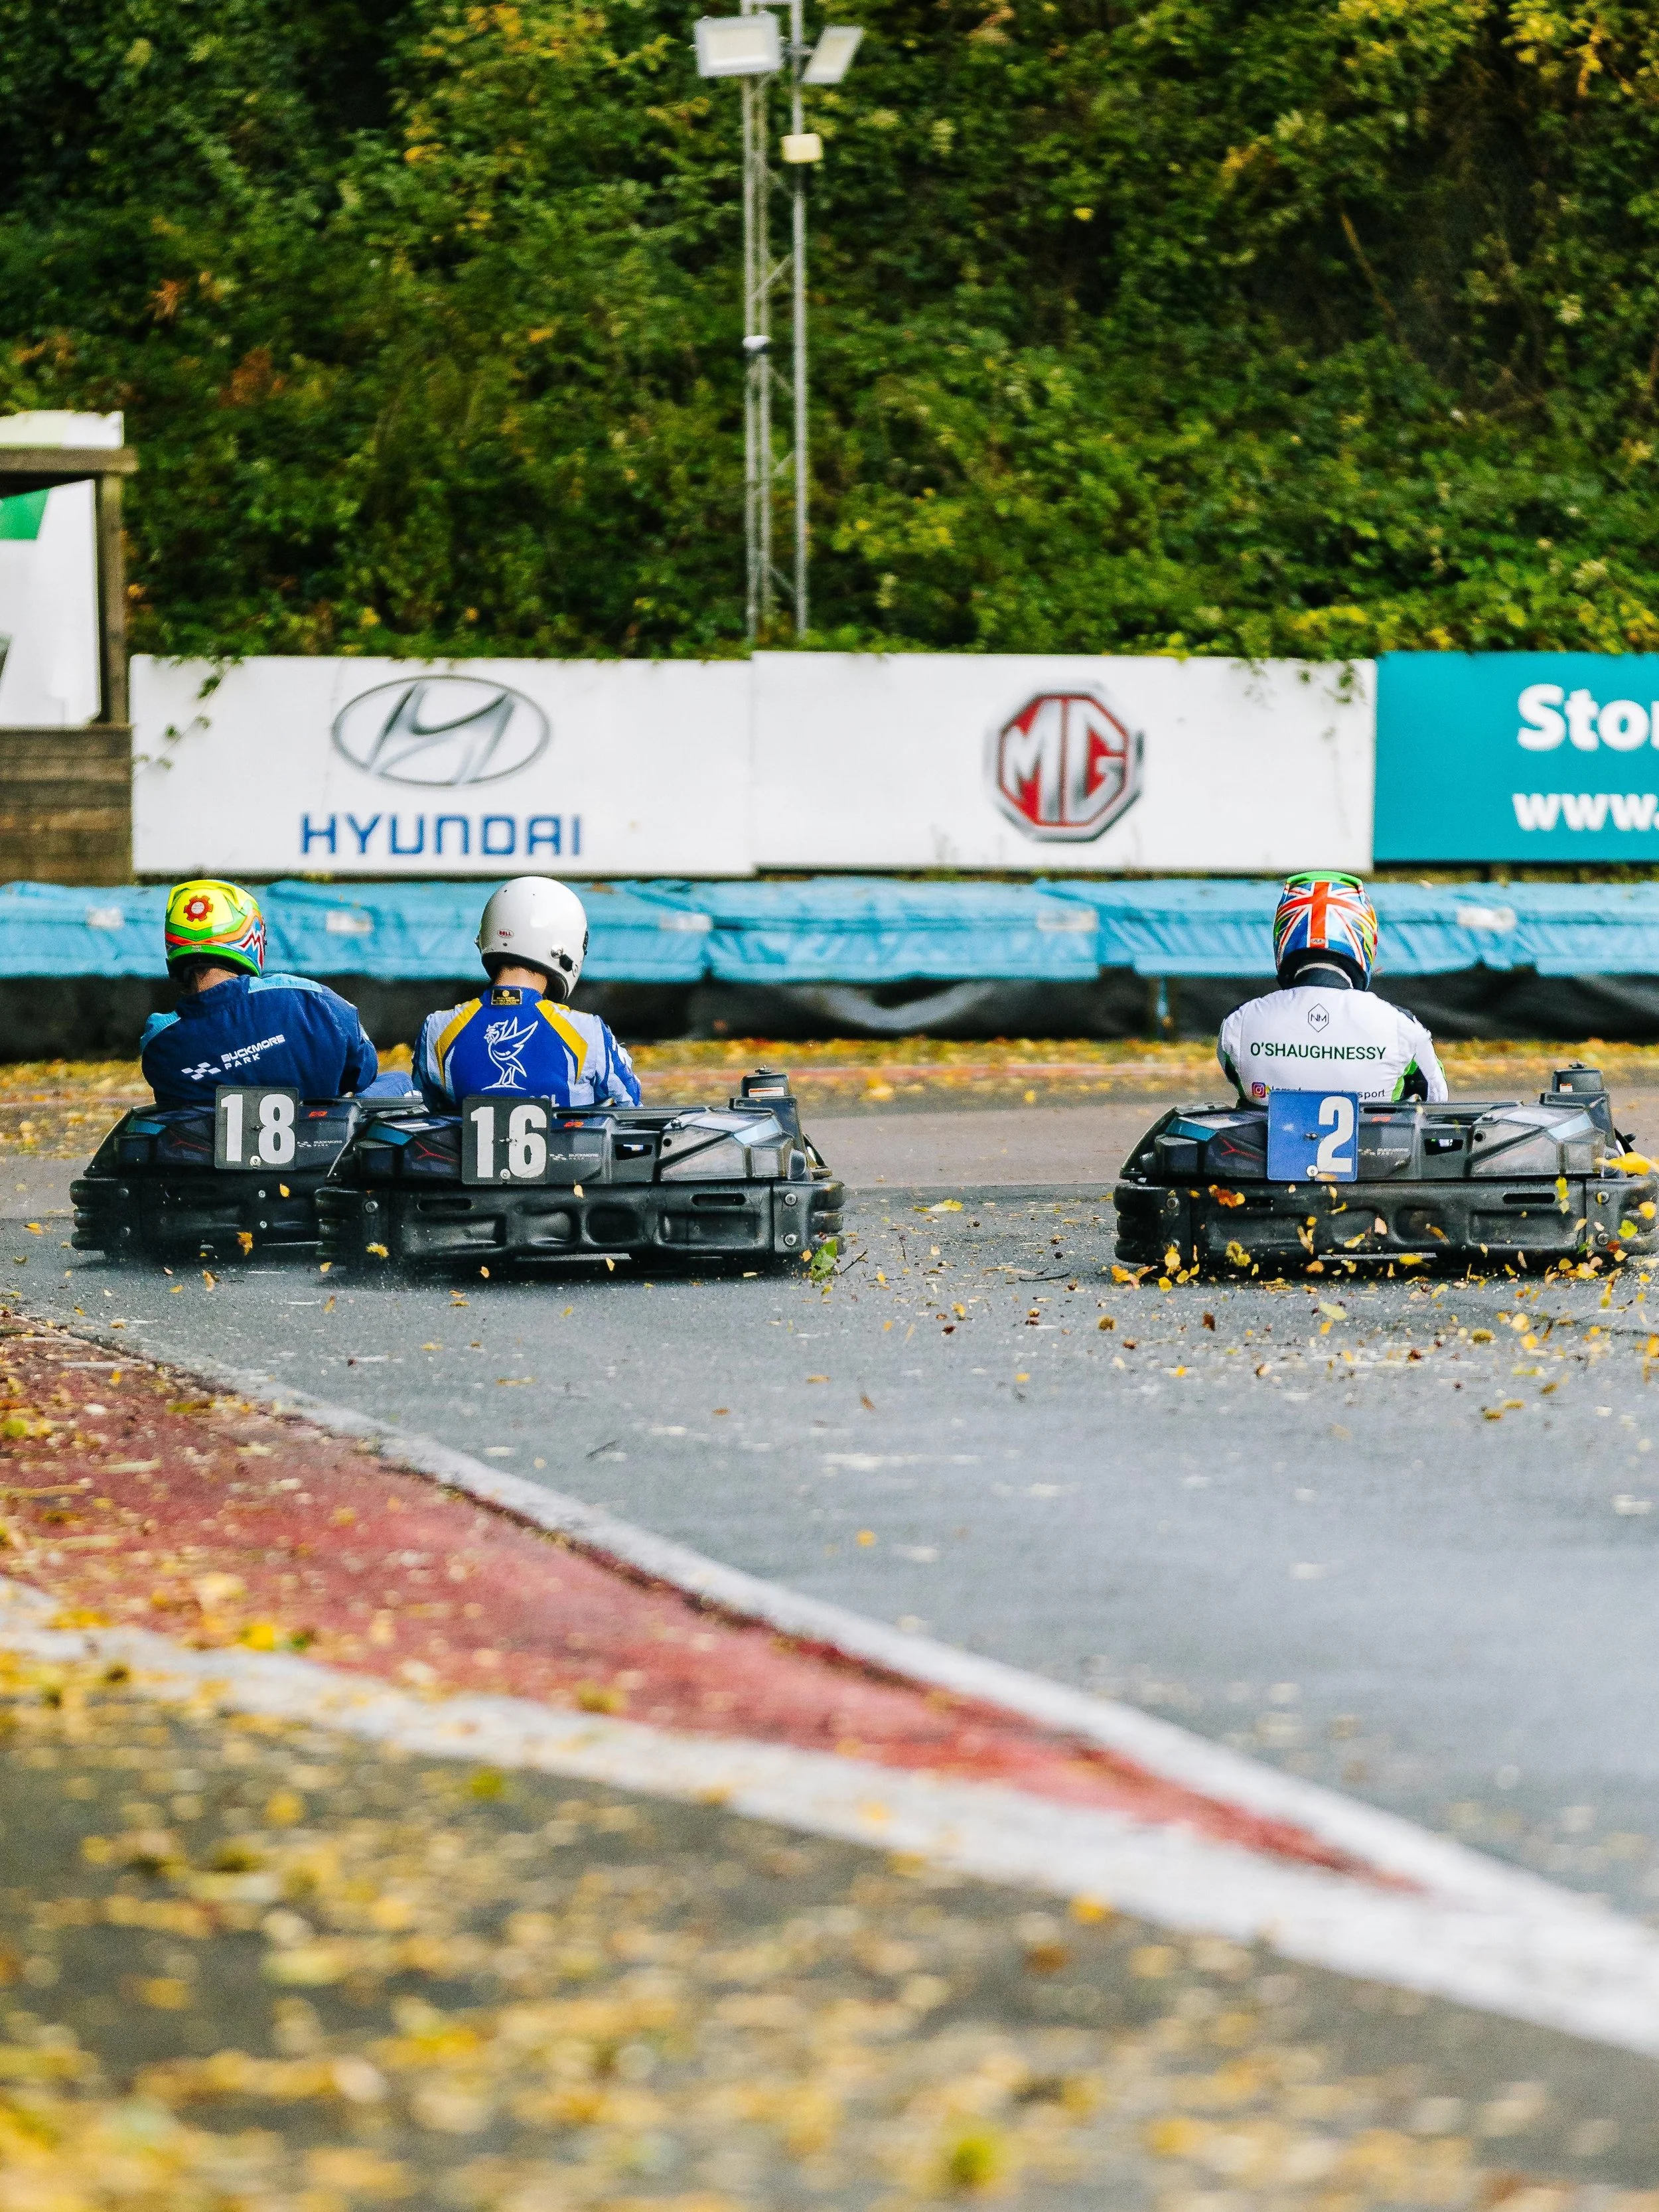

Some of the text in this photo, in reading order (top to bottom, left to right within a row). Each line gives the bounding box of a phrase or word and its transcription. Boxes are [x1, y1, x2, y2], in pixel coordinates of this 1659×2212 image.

[1517, 684, 1659, 752] Sto
[1003, 699, 1125, 824] MG
[300, 812, 582, 856] HYUNDAI
[1310, 1013, 1327, 1023] NM
[221, 1034, 285, 1063] BUCKMORE
[224, 1053, 260, 1070] PARK
[1250, 1042, 1386, 1060] O'SHAUGHNESSY
[221, 1094, 295, 1164] 18
[470, 1104, 547, 1178] 16
[1317, 1096, 1354, 1173] 2
